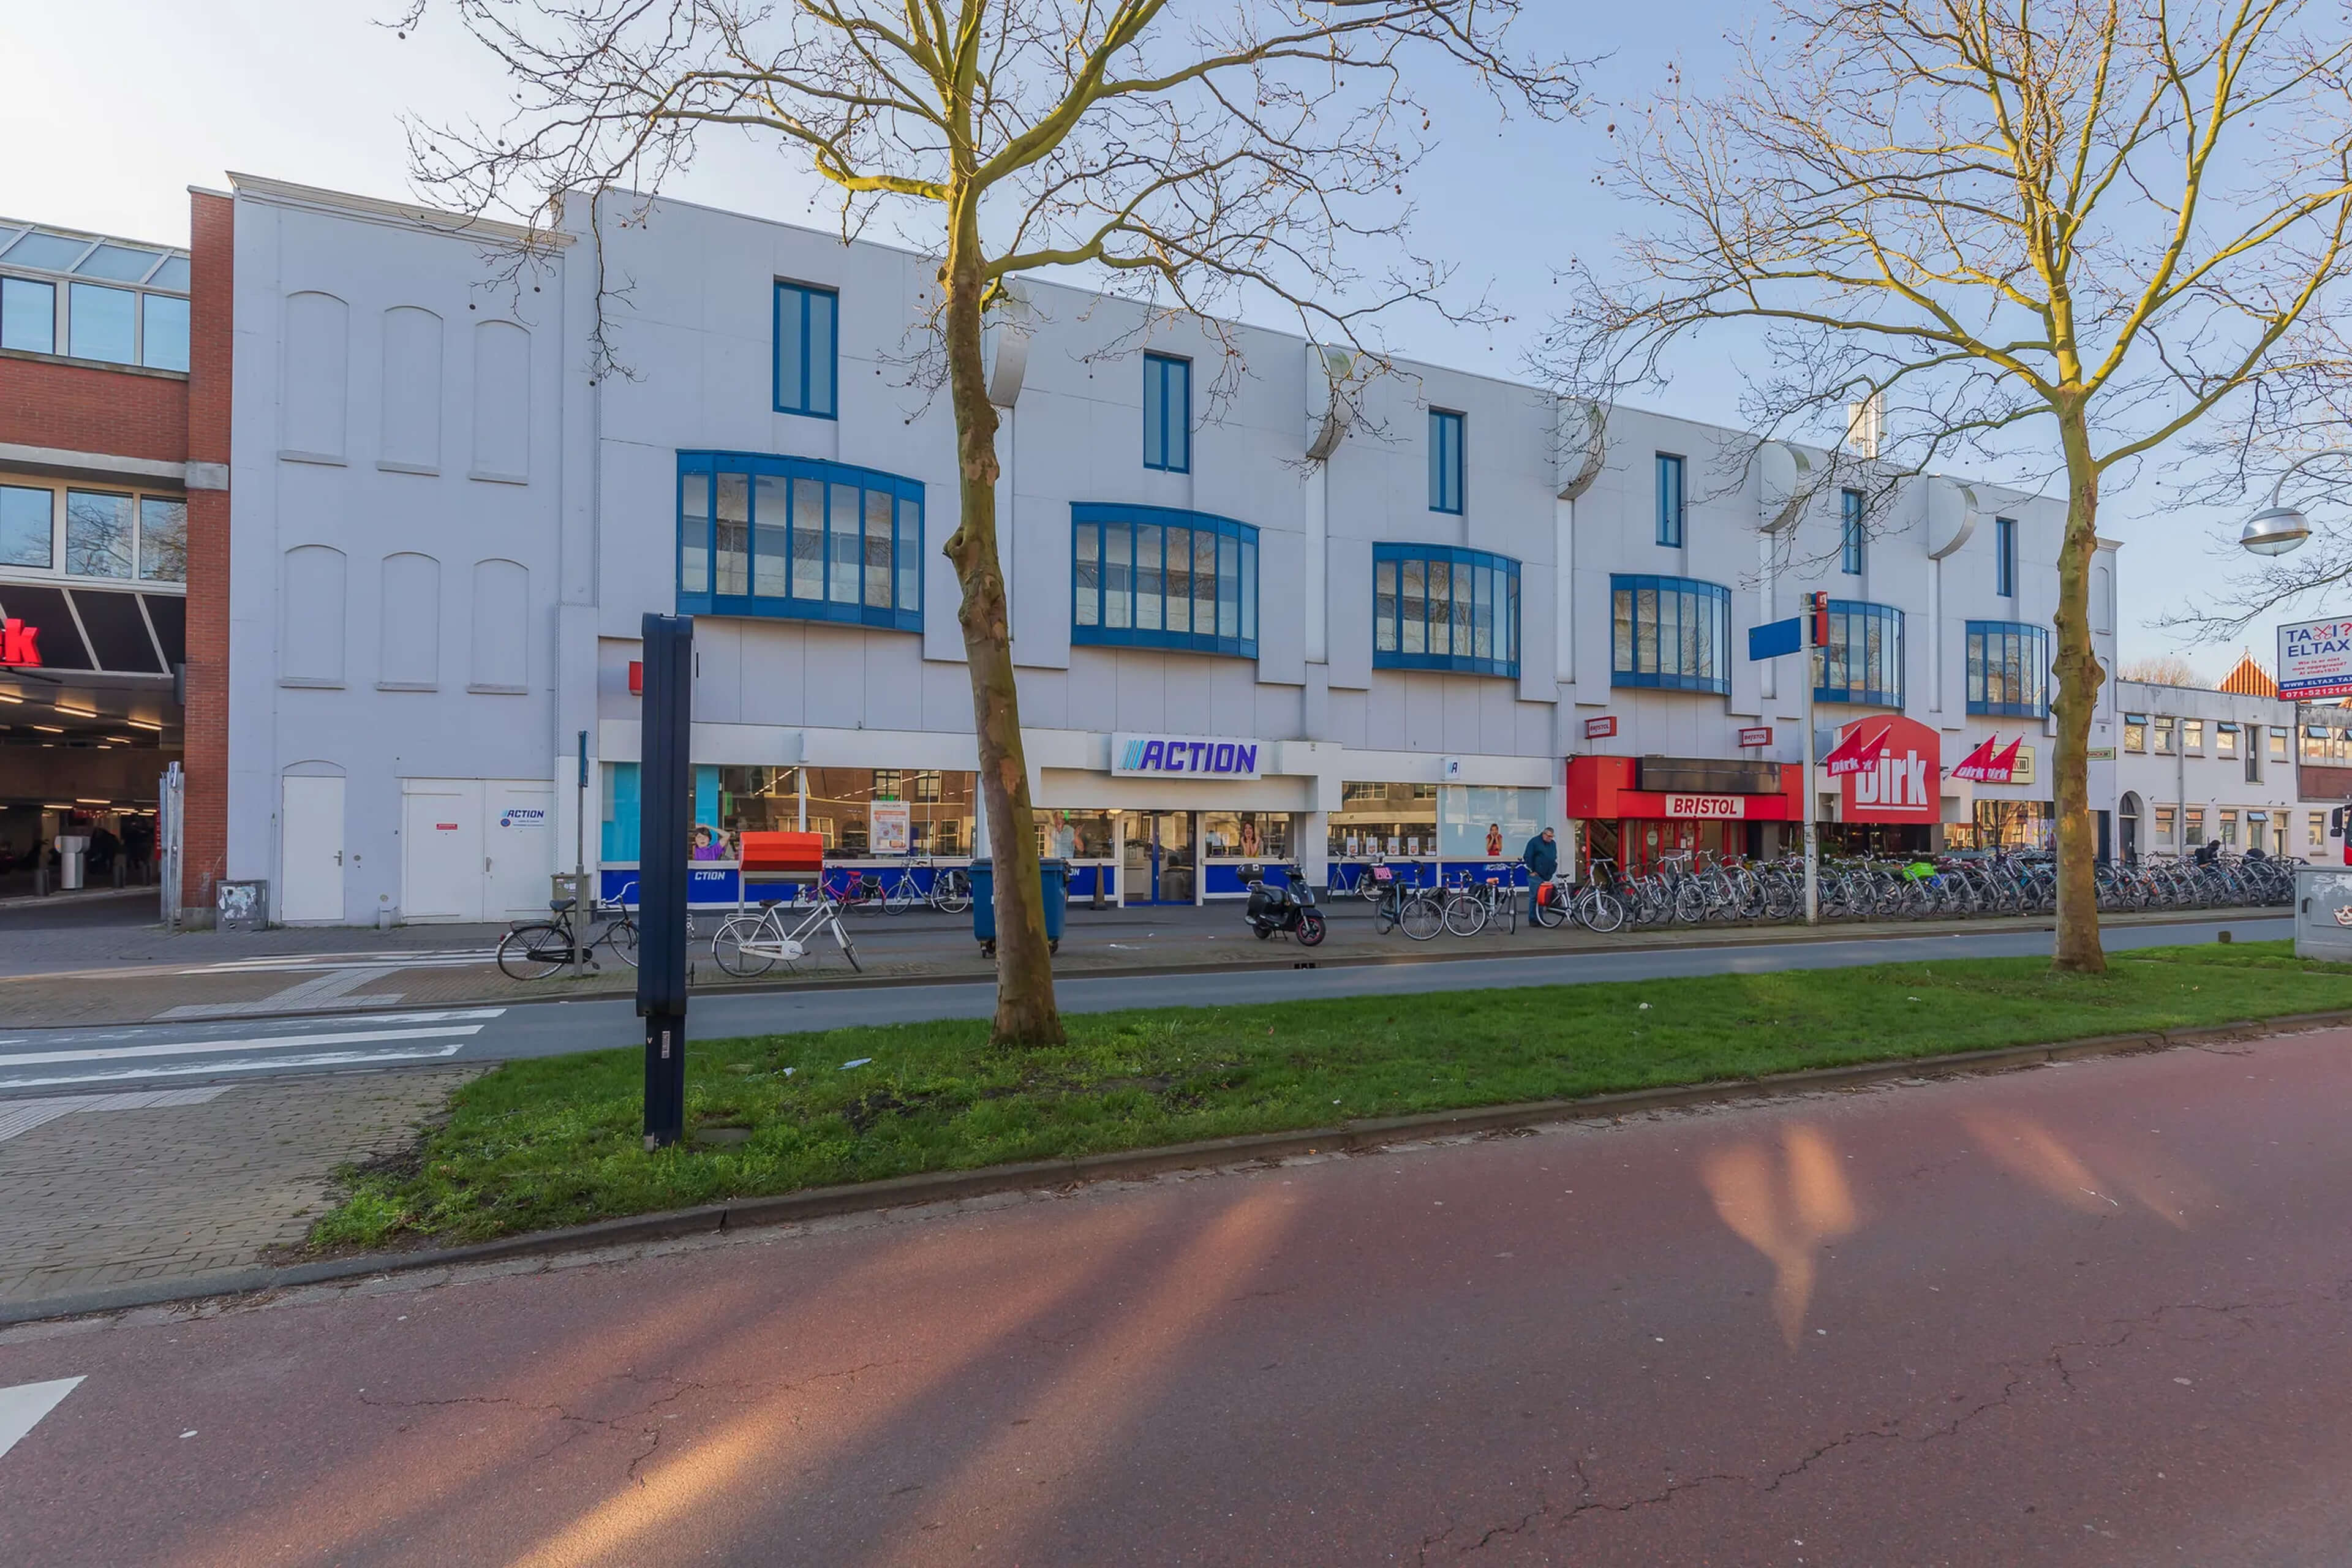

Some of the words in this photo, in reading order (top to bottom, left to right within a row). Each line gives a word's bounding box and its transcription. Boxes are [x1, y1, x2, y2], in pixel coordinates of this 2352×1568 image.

[2288, 639, 2351, 657] ELTAX
[1589, 723, 1610, 732] BRISTOL
[1744, 733, 1765, 742] BRISTOL
[1140, 740, 1257, 773] ACTION
[1831, 757, 1860, 774] Dirk
[1956, 766, 1985, 778] Dirk
[1673, 797, 1737, 818] BRISTOL
[507, 810, 545, 818] ACTION
[695, 872, 725, 880] CTION
